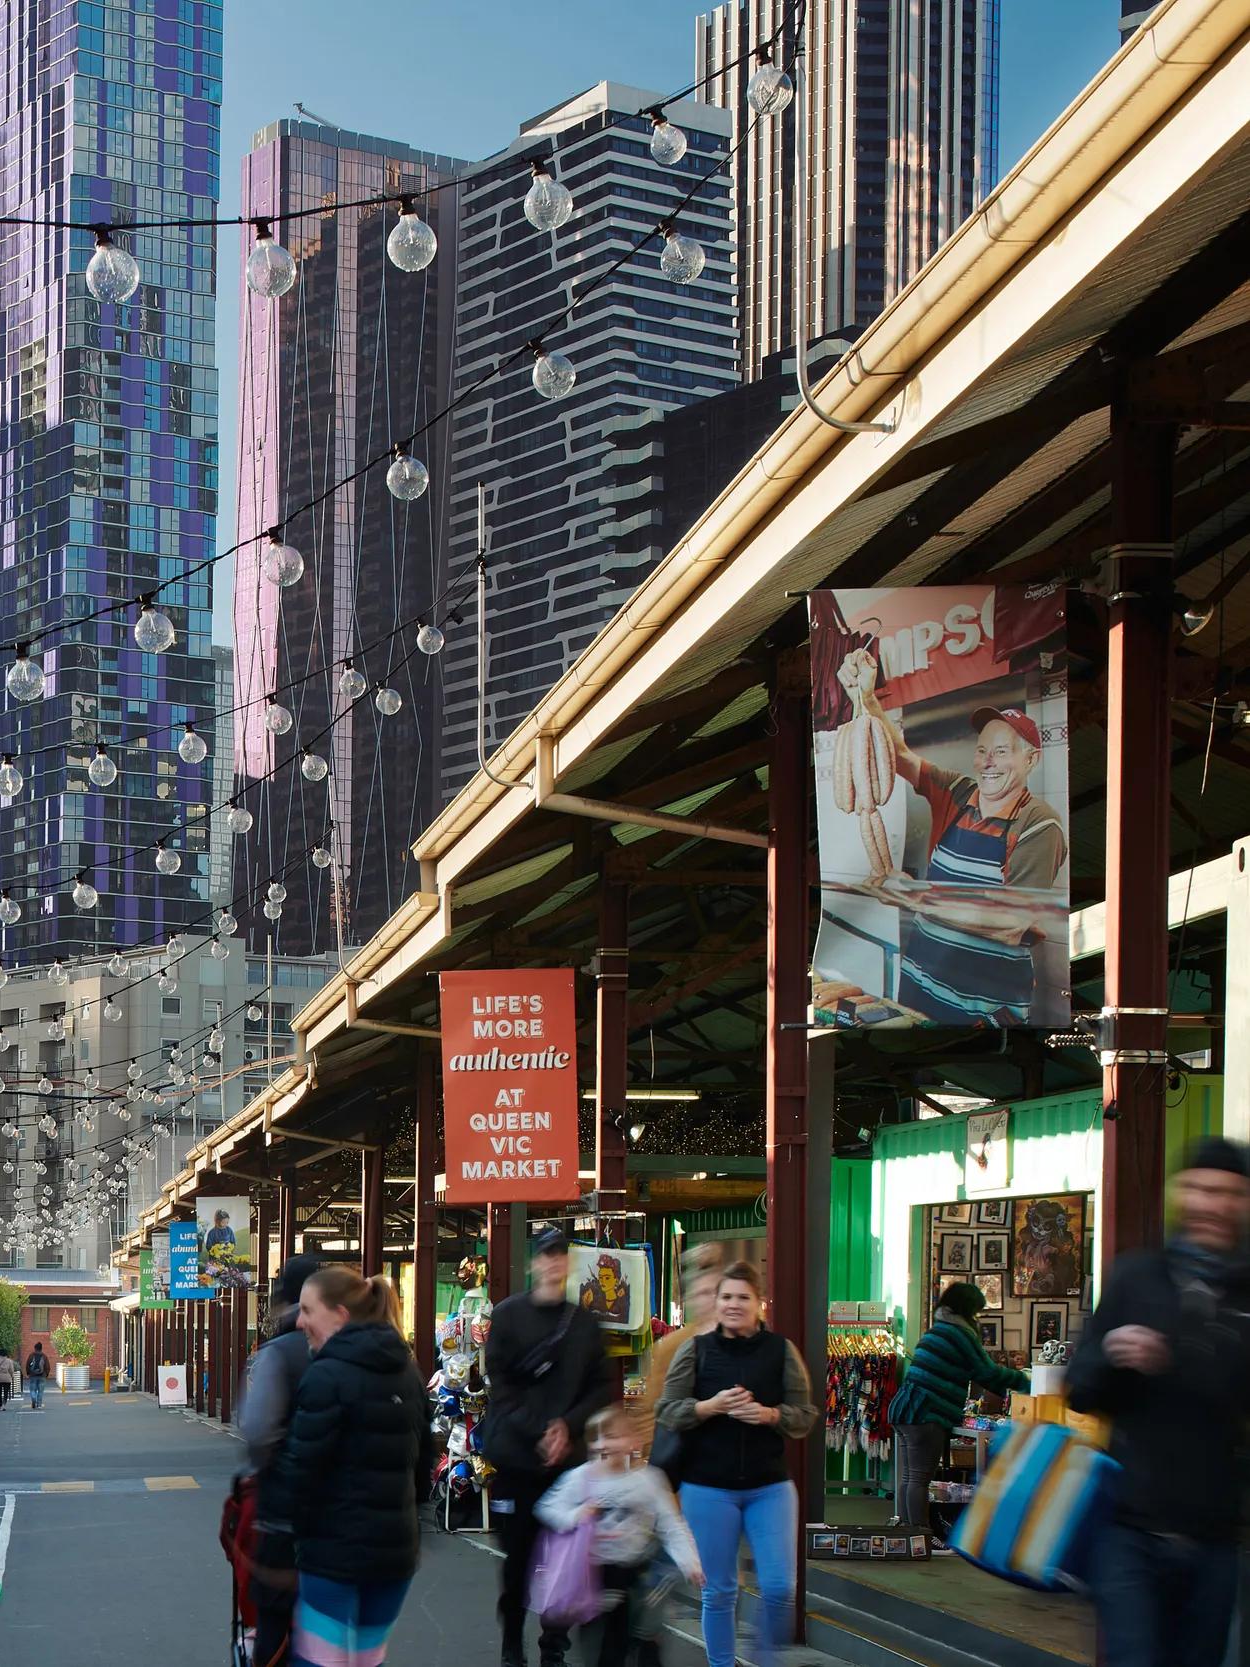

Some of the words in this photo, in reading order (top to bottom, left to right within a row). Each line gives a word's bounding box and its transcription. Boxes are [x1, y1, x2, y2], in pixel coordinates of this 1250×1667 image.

[472, 995, 543, 1015] LIFE'S
[473, 1019, 544, 1039] MORE
[450, 1045, 570, 1072] authentic
[495, 1088, 525, 1107] AT
[469, 1111, 551, 1131] QUEEN
[490, 1136, 532, 1155] VIC
[461, 1159, 562, 1180] MARKET
